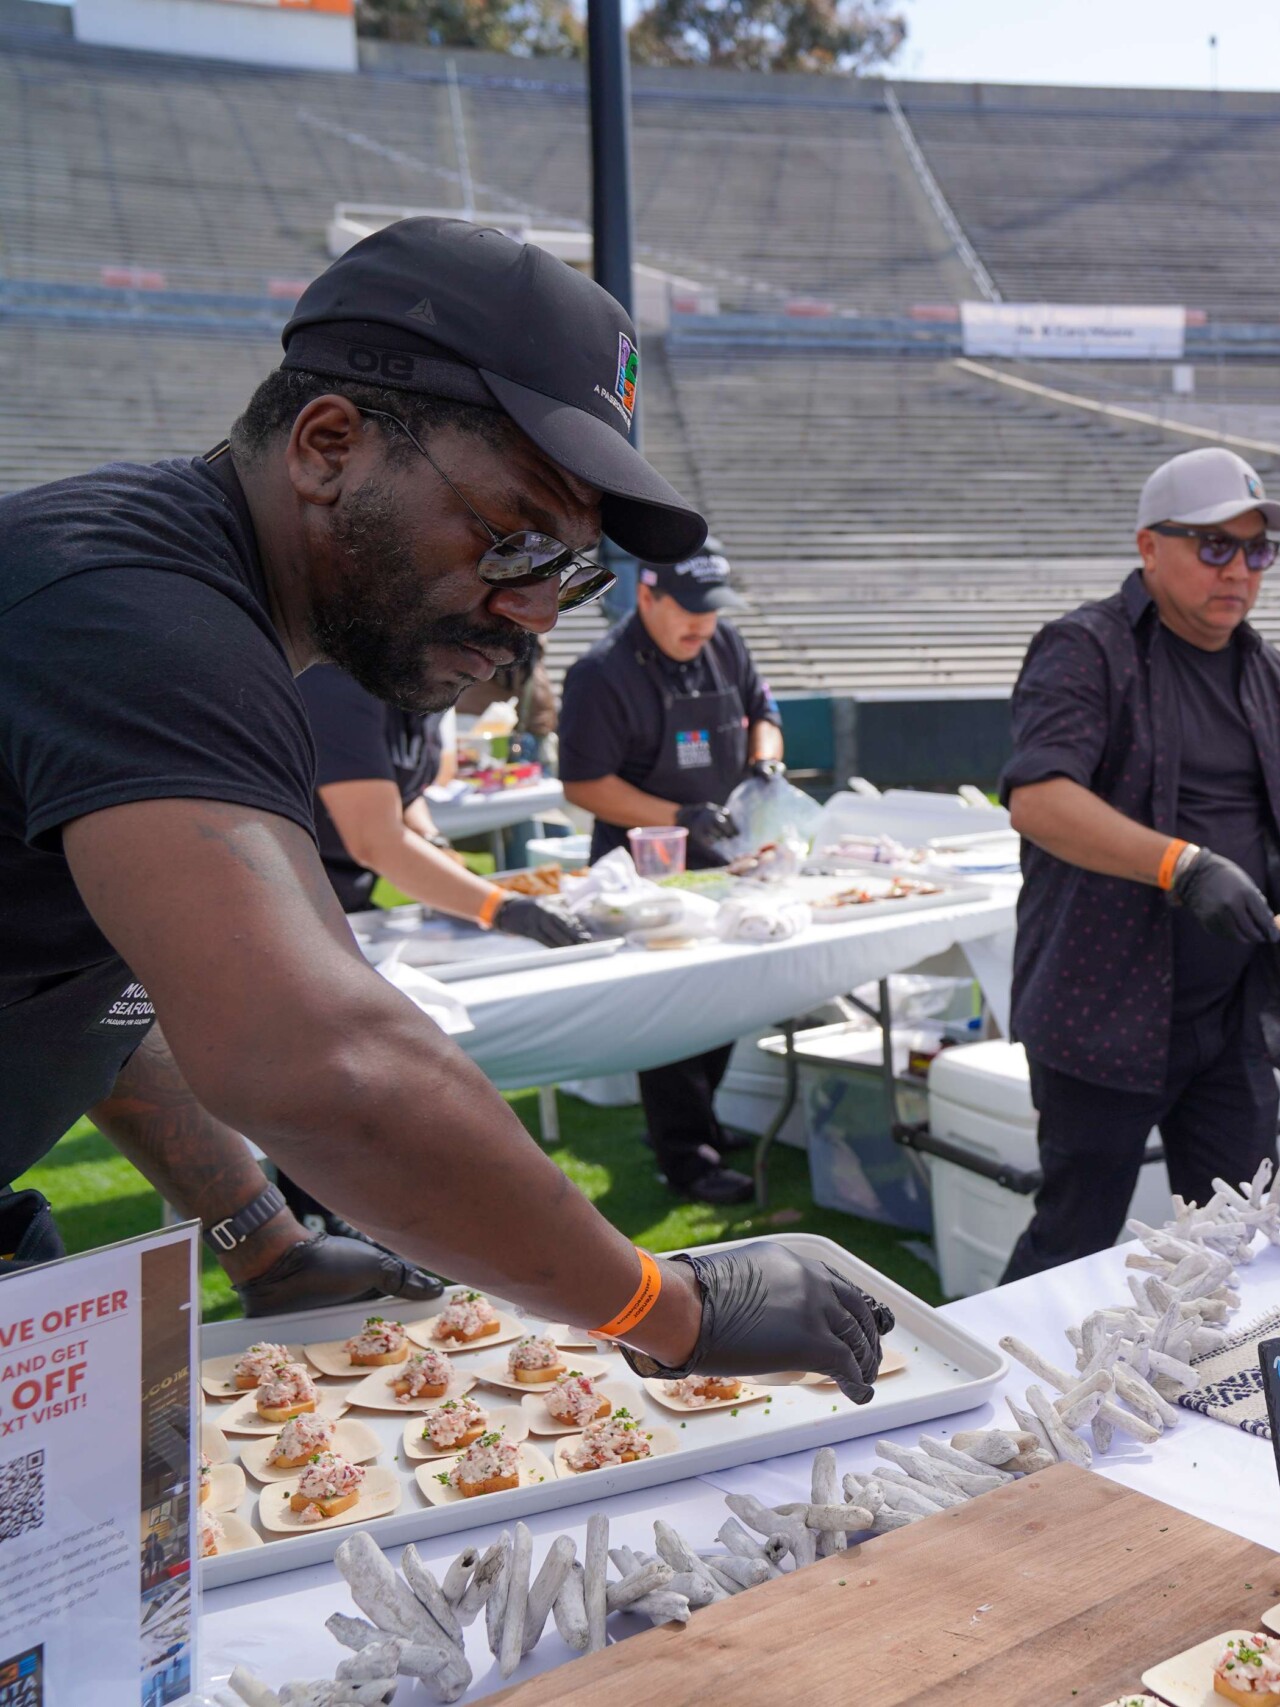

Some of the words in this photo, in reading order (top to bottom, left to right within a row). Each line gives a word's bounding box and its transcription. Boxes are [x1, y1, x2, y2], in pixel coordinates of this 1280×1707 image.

[42, 1290, 128, 1333] OFFER
[2, 1355, 46, 1382] AND
[51, 1340, 88, 1364] GET
[12, 1361, 87, 1410] OFF
[0, 1415, 27, 1437] XT
[32, 1393, 87, 1424] VISIT!
